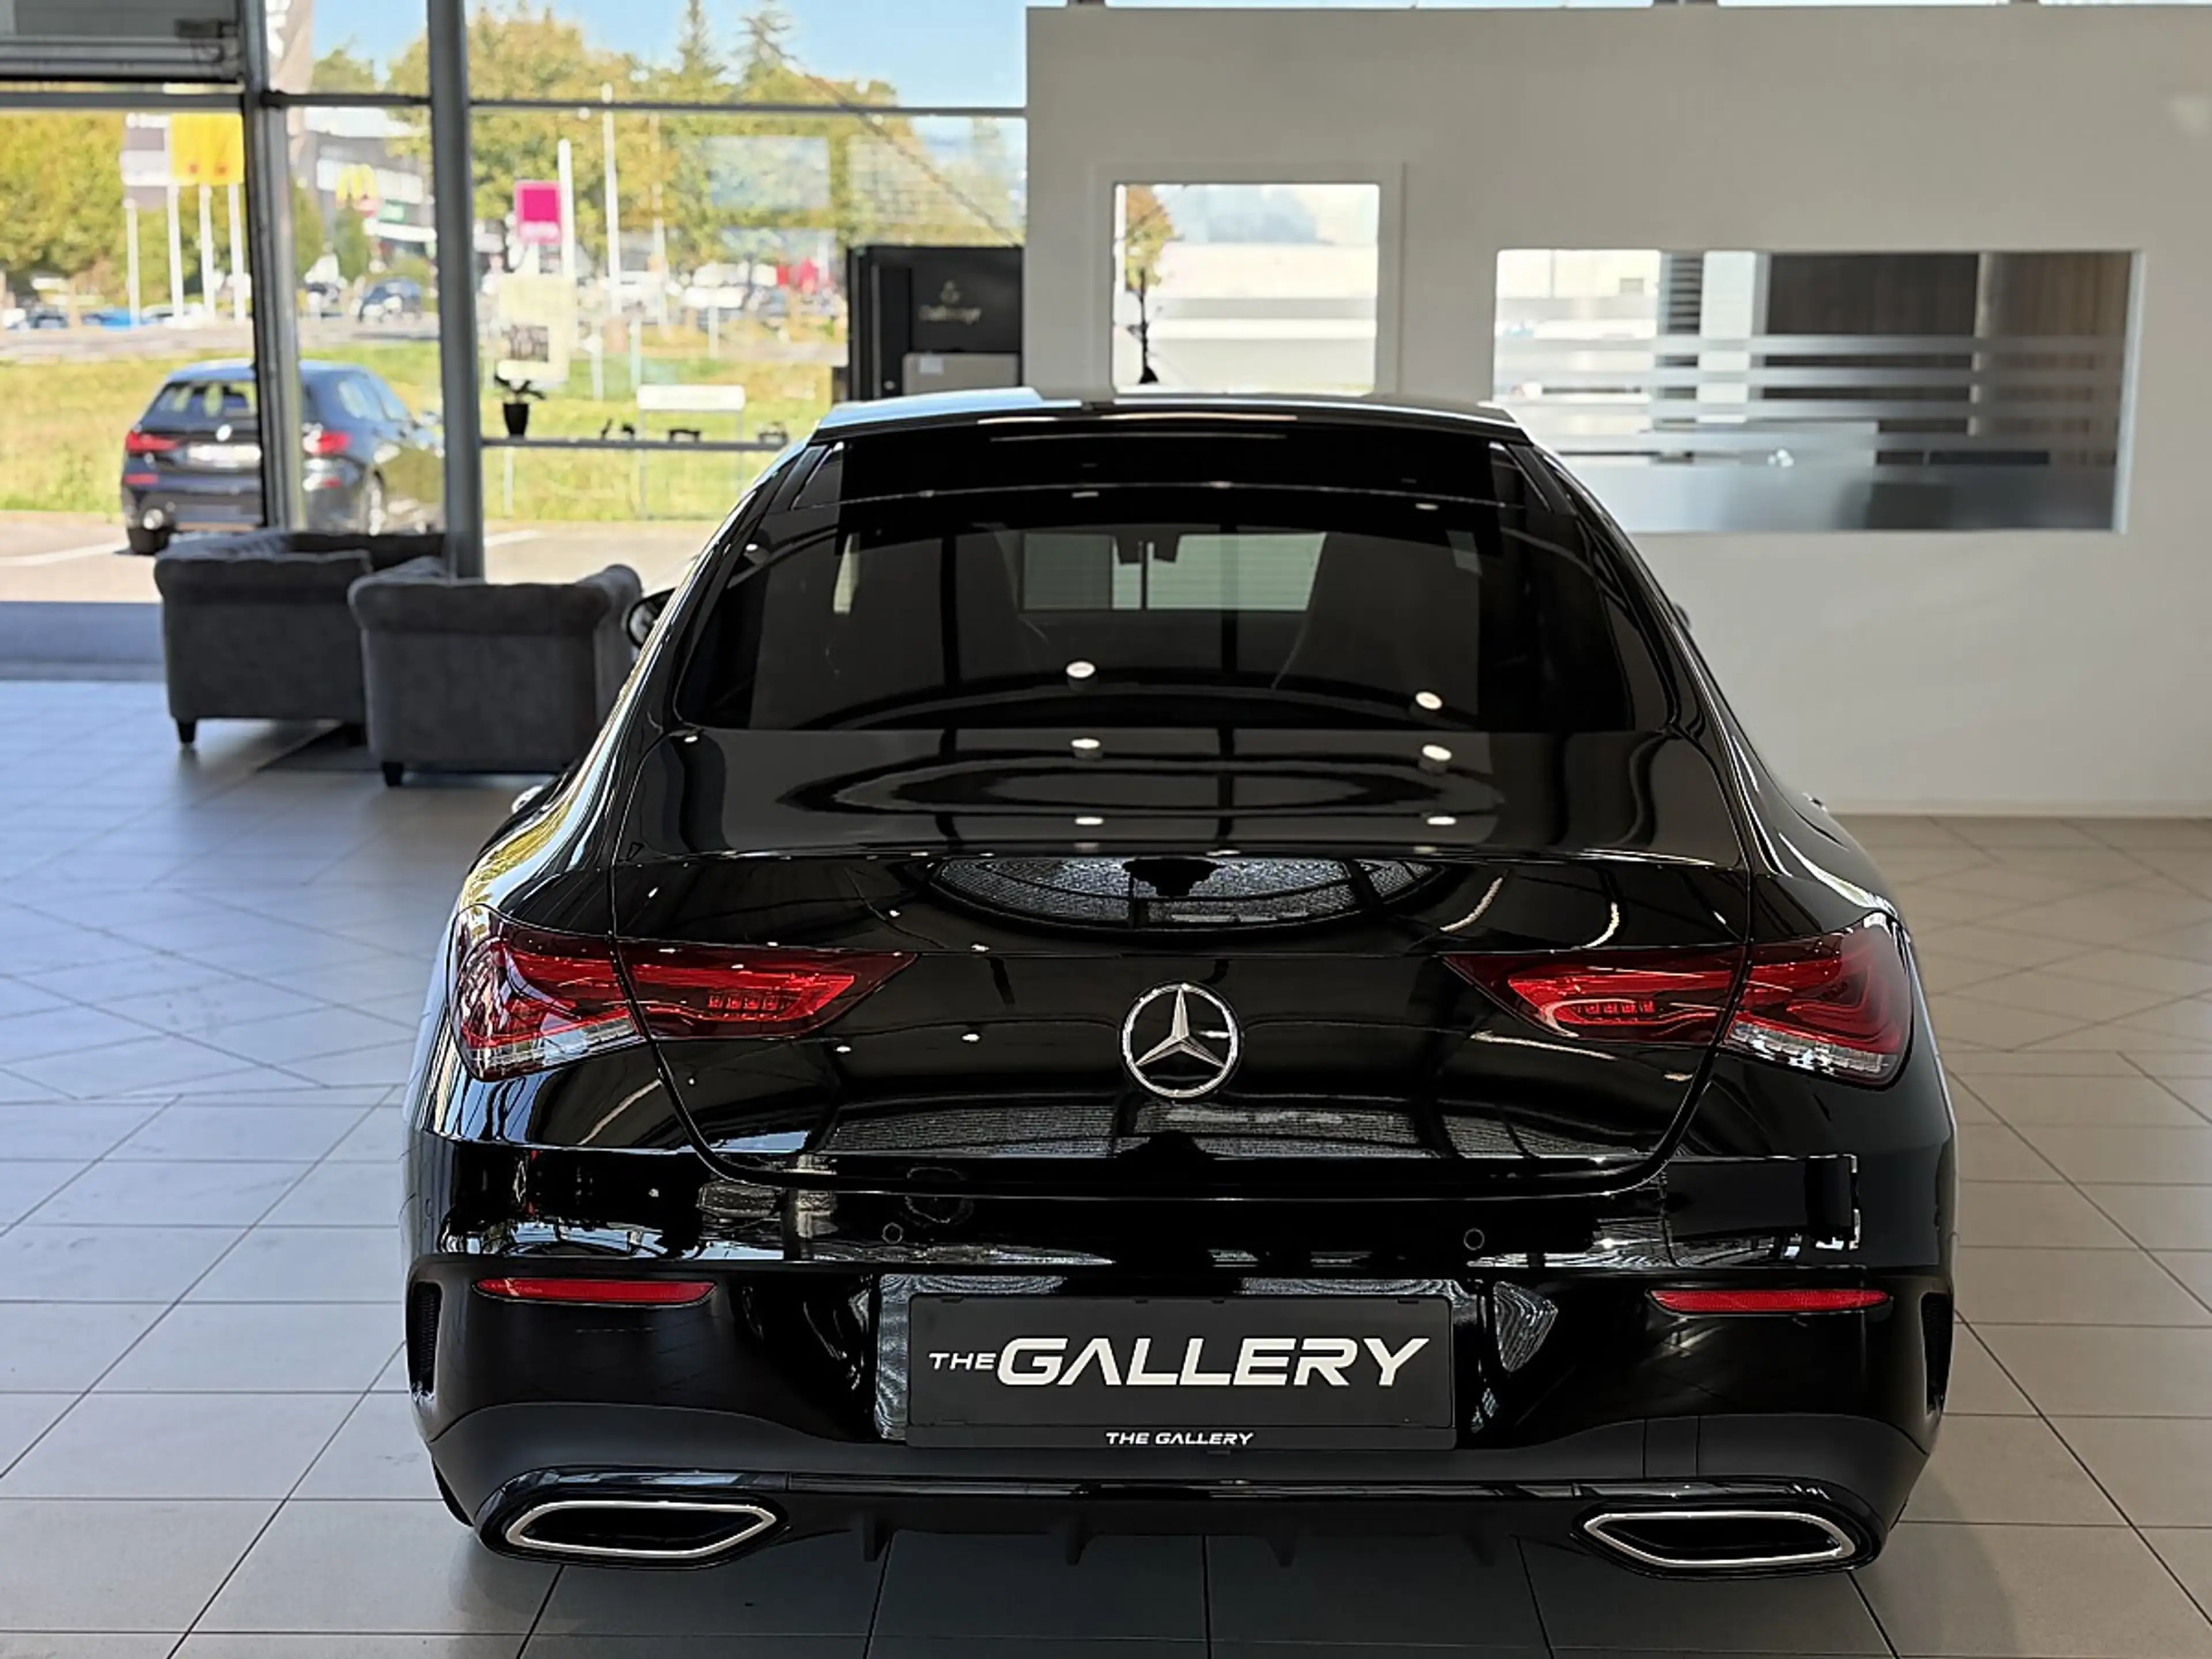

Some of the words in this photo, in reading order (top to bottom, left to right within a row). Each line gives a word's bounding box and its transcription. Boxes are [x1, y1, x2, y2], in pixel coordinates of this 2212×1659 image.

[929, 1352, 997, 1370] THE
[997, 1338, 1430, 1387] GALLERY
[1105, 1431, 1150, 1445] THE
[1154, 1431, 1254, 1446] GALLERY
